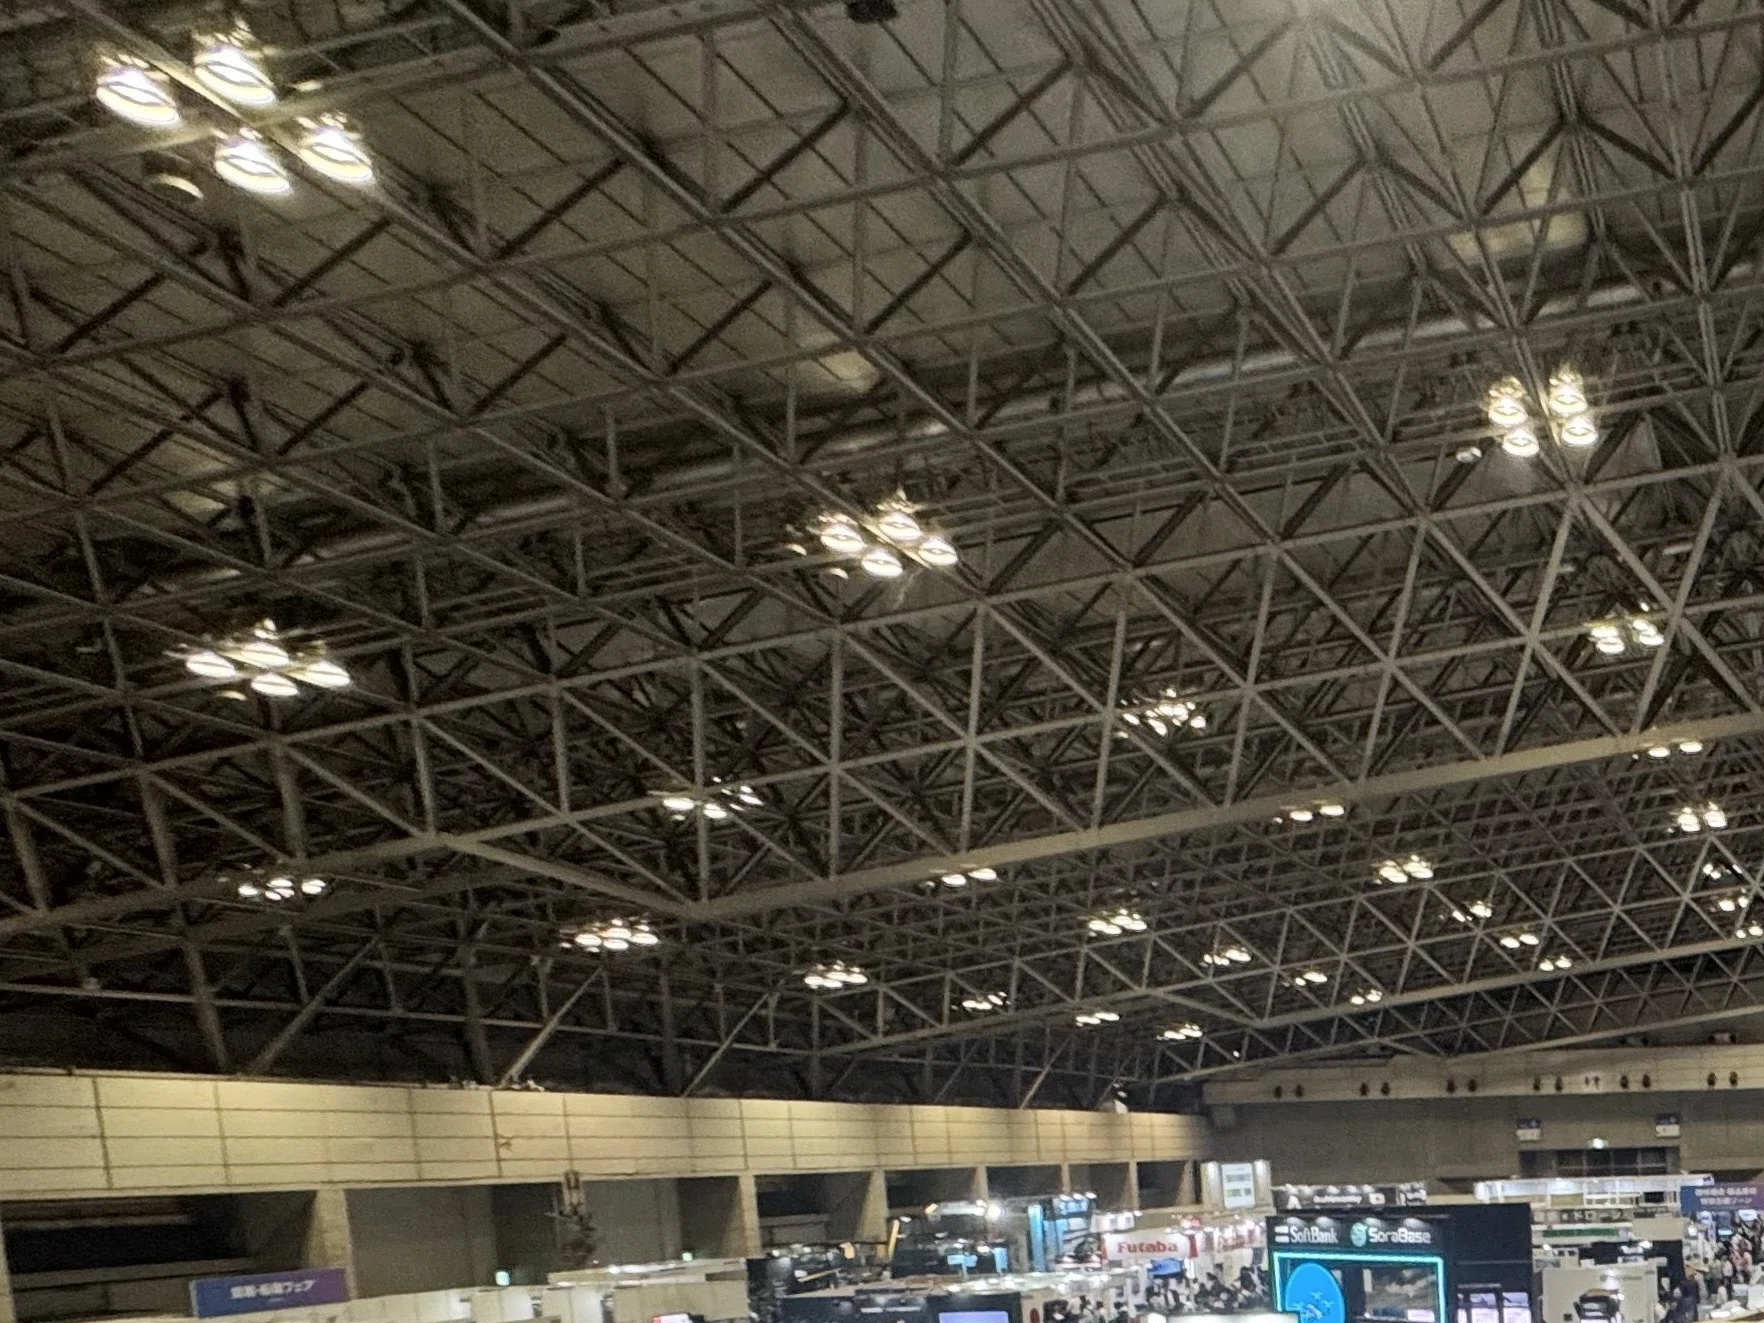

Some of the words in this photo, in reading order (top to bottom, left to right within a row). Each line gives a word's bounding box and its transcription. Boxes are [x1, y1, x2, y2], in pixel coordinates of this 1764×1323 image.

[1289, 1225, 1338, 1243] SoftBank
[1368, 1227, 1432, 1244] SoraBase
[1117, 1241, 1178, 1253] Futaba
